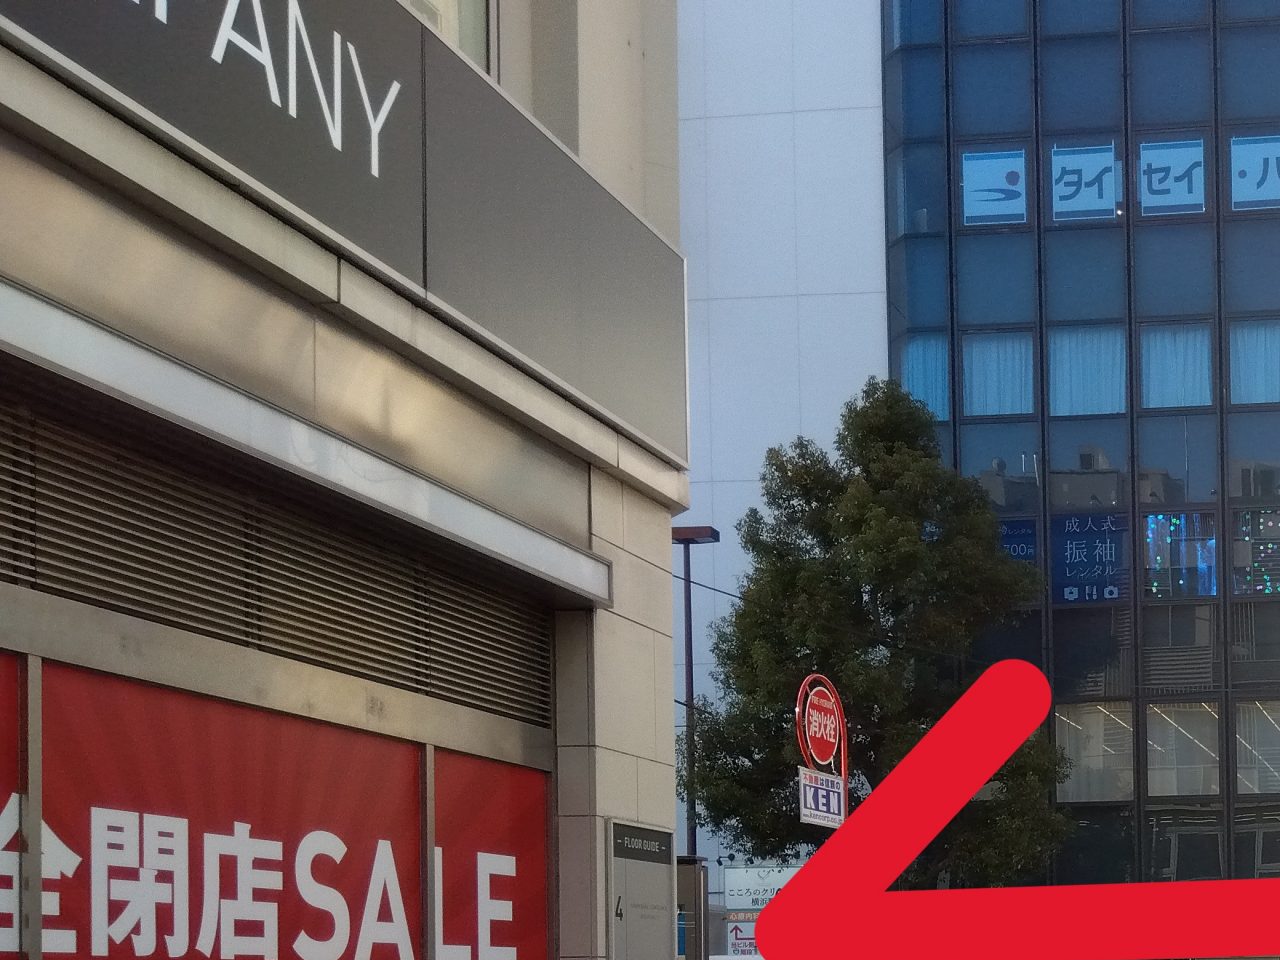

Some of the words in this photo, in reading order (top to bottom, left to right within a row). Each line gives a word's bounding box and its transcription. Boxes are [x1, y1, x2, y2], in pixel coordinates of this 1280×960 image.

[117, 0, 401, 178] ANY
[1064, 515, 1117, 533] 成人式
[1064, 538, 1116, 563] 振袖
[1065, 564, 1117, 578] レンタル
[809, 708, 836, 743] 消火栓
[805, 786, 839, 815] KEN
[624, 836, 643, 851] FLOOR
[643, 840, 660, 853] GUIDE
[614, 895, 624, 922] 4
